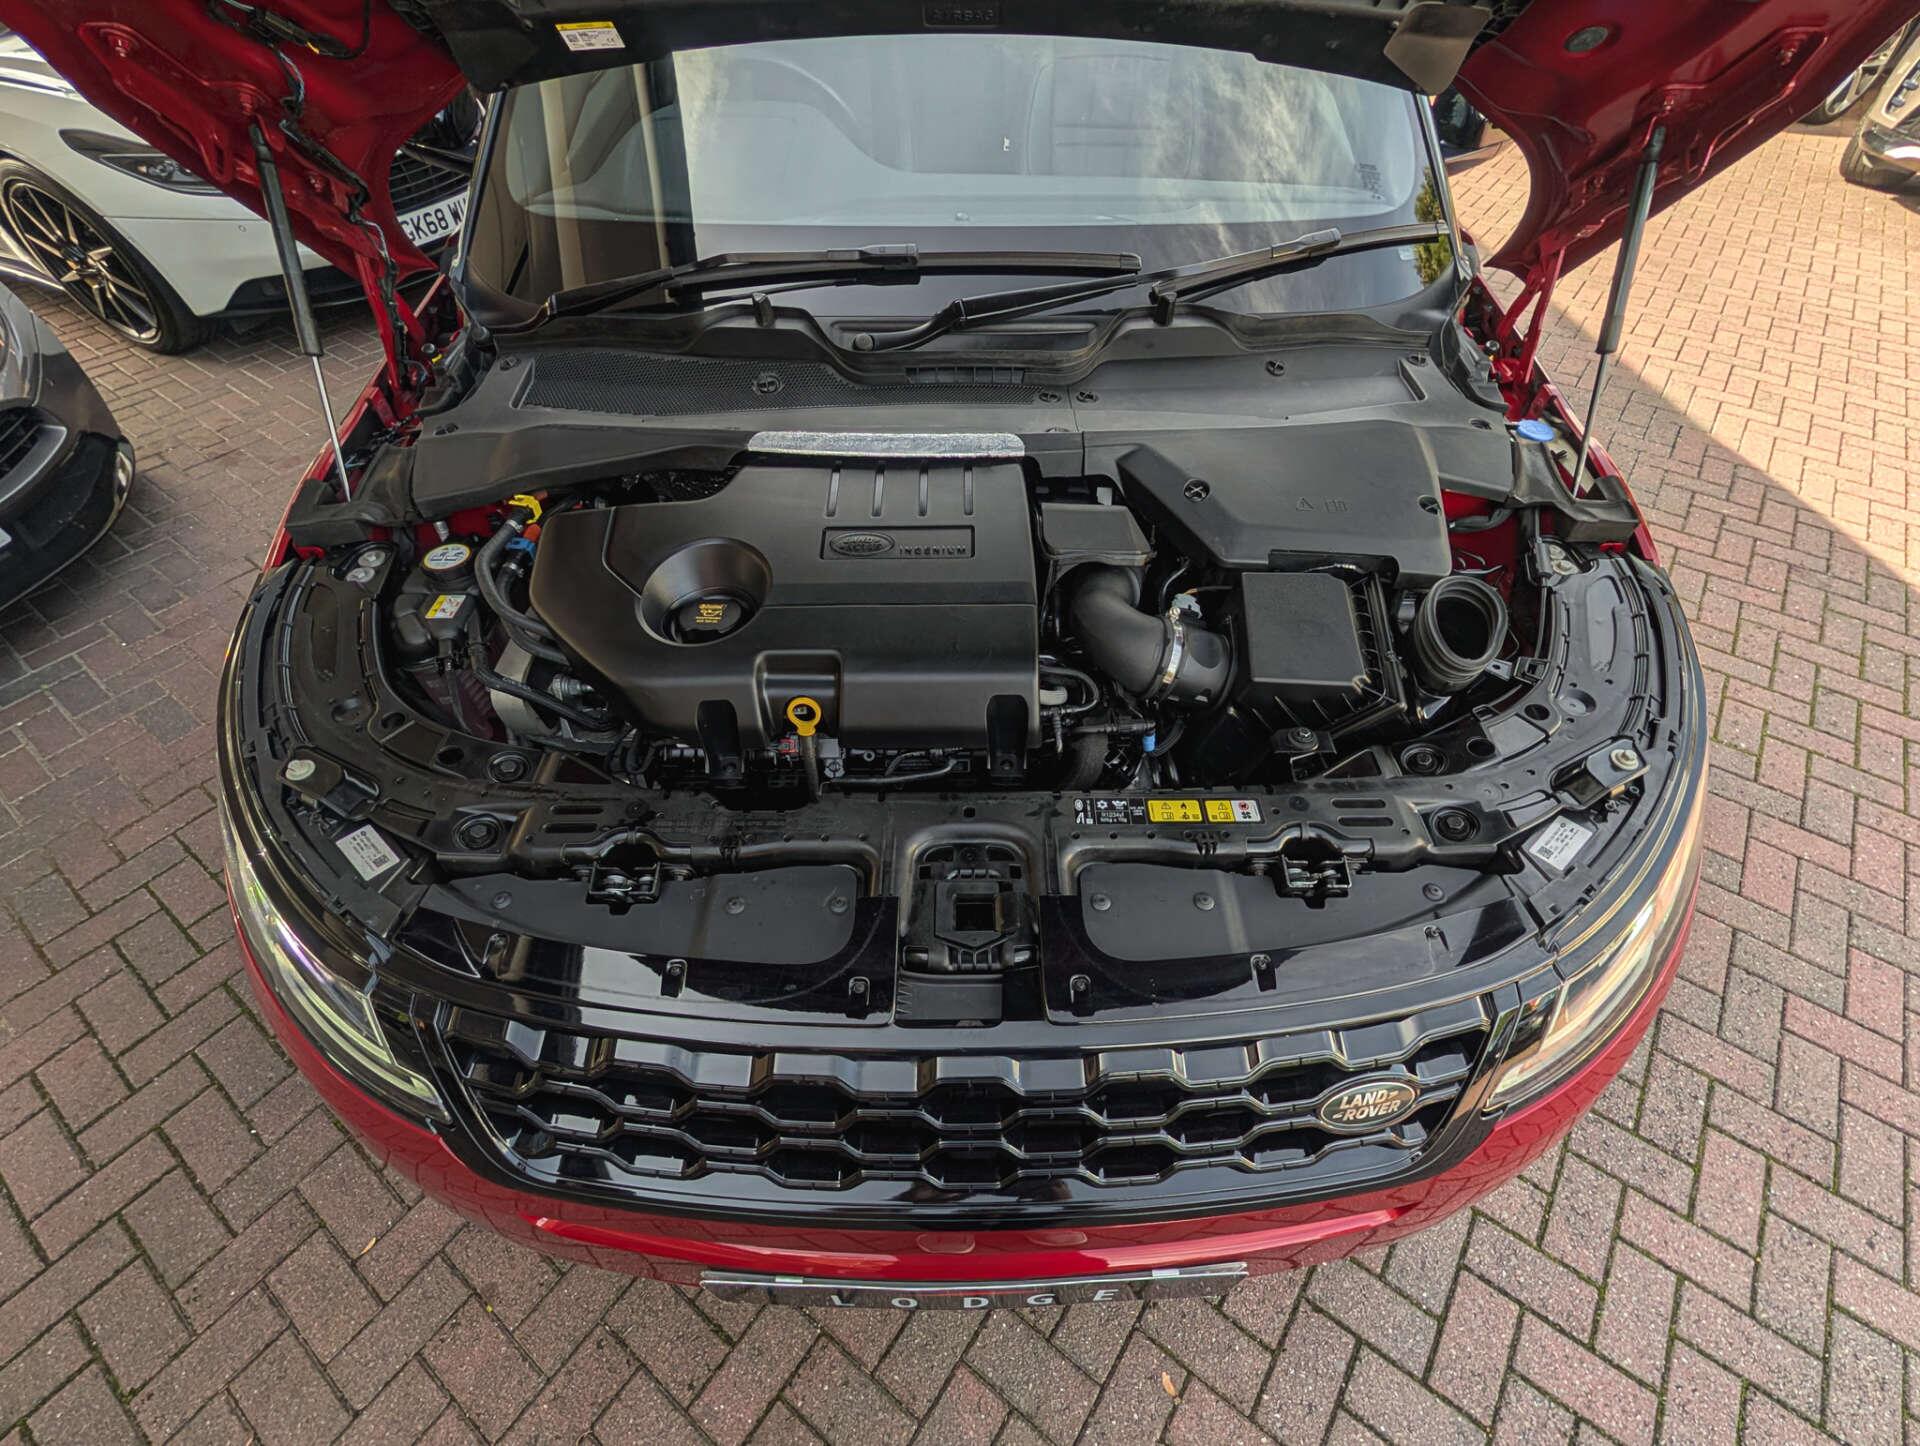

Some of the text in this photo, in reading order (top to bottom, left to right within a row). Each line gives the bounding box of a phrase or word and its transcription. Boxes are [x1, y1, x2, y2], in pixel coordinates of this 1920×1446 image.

[400, 208, 449, 241] GK68
[899, 545, 967, 555] INGENIUM
[1340, 1089, 1389, 1110] LAND
[1342, 1099, 1401, 1121] ROVER
[830, 1289, 1119, 1308] LODGE
